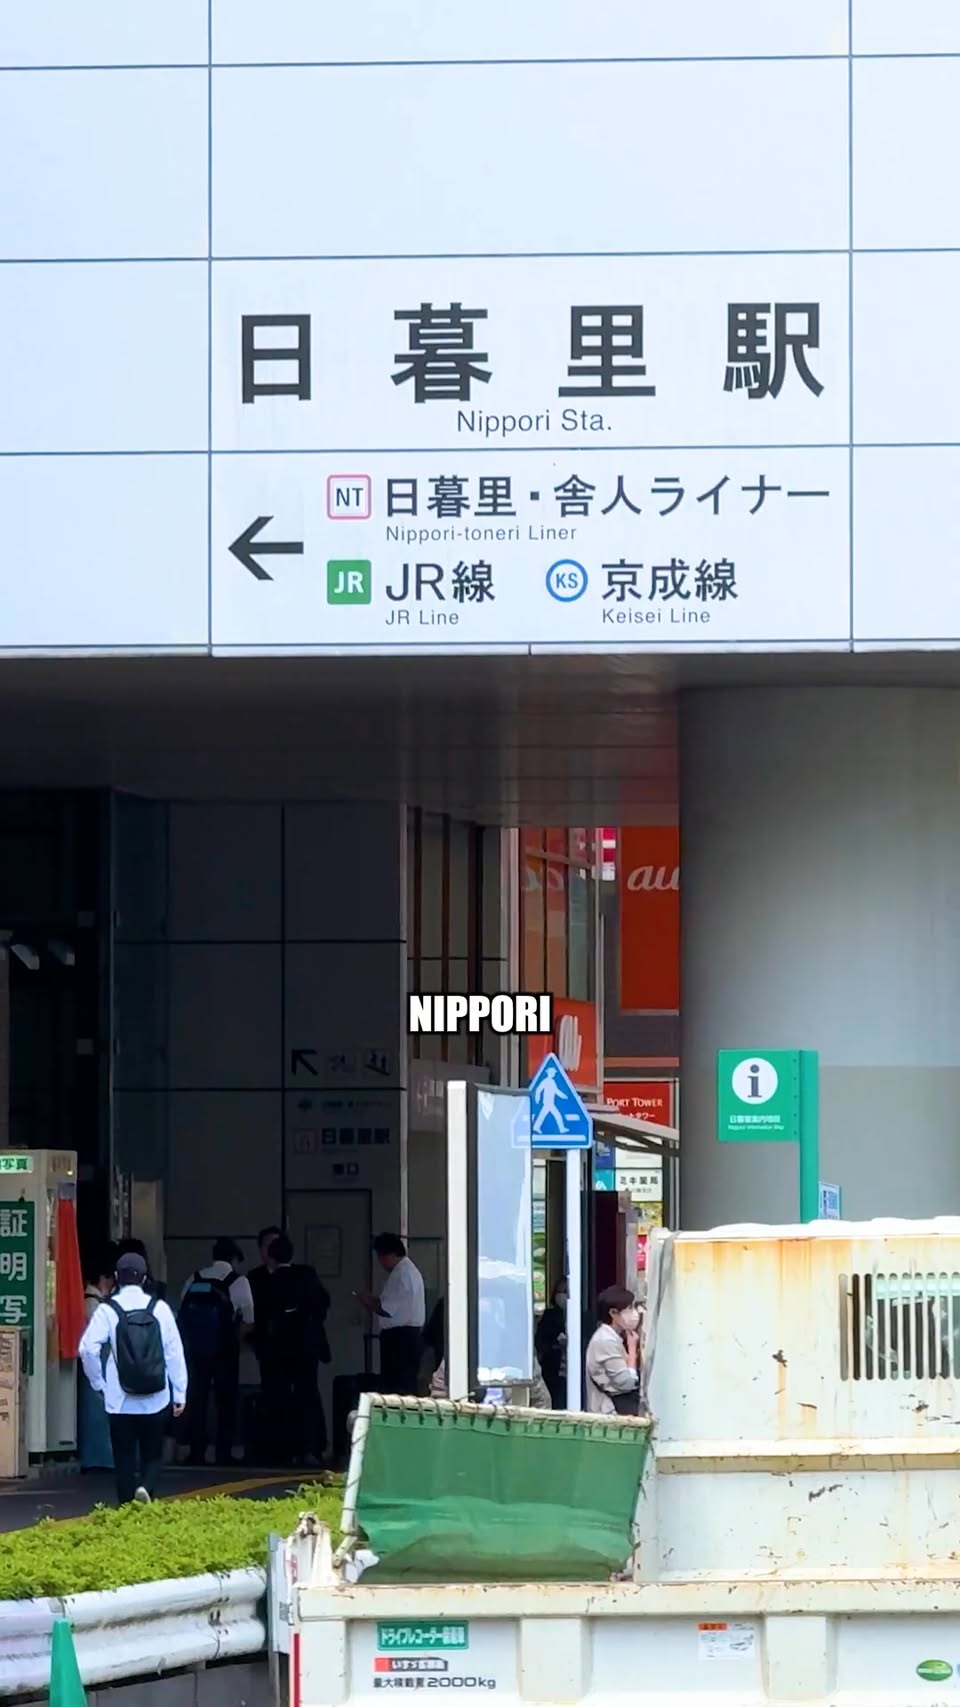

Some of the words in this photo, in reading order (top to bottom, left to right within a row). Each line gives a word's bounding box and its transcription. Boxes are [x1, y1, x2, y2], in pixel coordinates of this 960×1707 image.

[240, 302, 825, 405] 日暮里駅
[457, 409, 550, 437] Nippori
[562, 409, 612, 431] Sta.
[336, 487, 363, 507] NT
[386, 474, 829, 518] 日暮里・舎人ライナー
[386, 525, 520, 544] Nippori-toneri
[528, 524, 577, 541] Liner
[334, 571, 364, 593] JR
[386, 560, 496, 603] JR線
[556, 574, 578, 590] KS
[601, 558, 738, 603] 京成線
[385, 610, 410, 625] JR
[420, 609, 459, 625] Line
[602, 609, 661, 624] Keisei
[670, 608, 711, 624] Line
[631, 1097, 663, 1108] TOWER
[0, 1158, 27, 1170] 写真
[0, 1208, 28, 1324] 証明写
